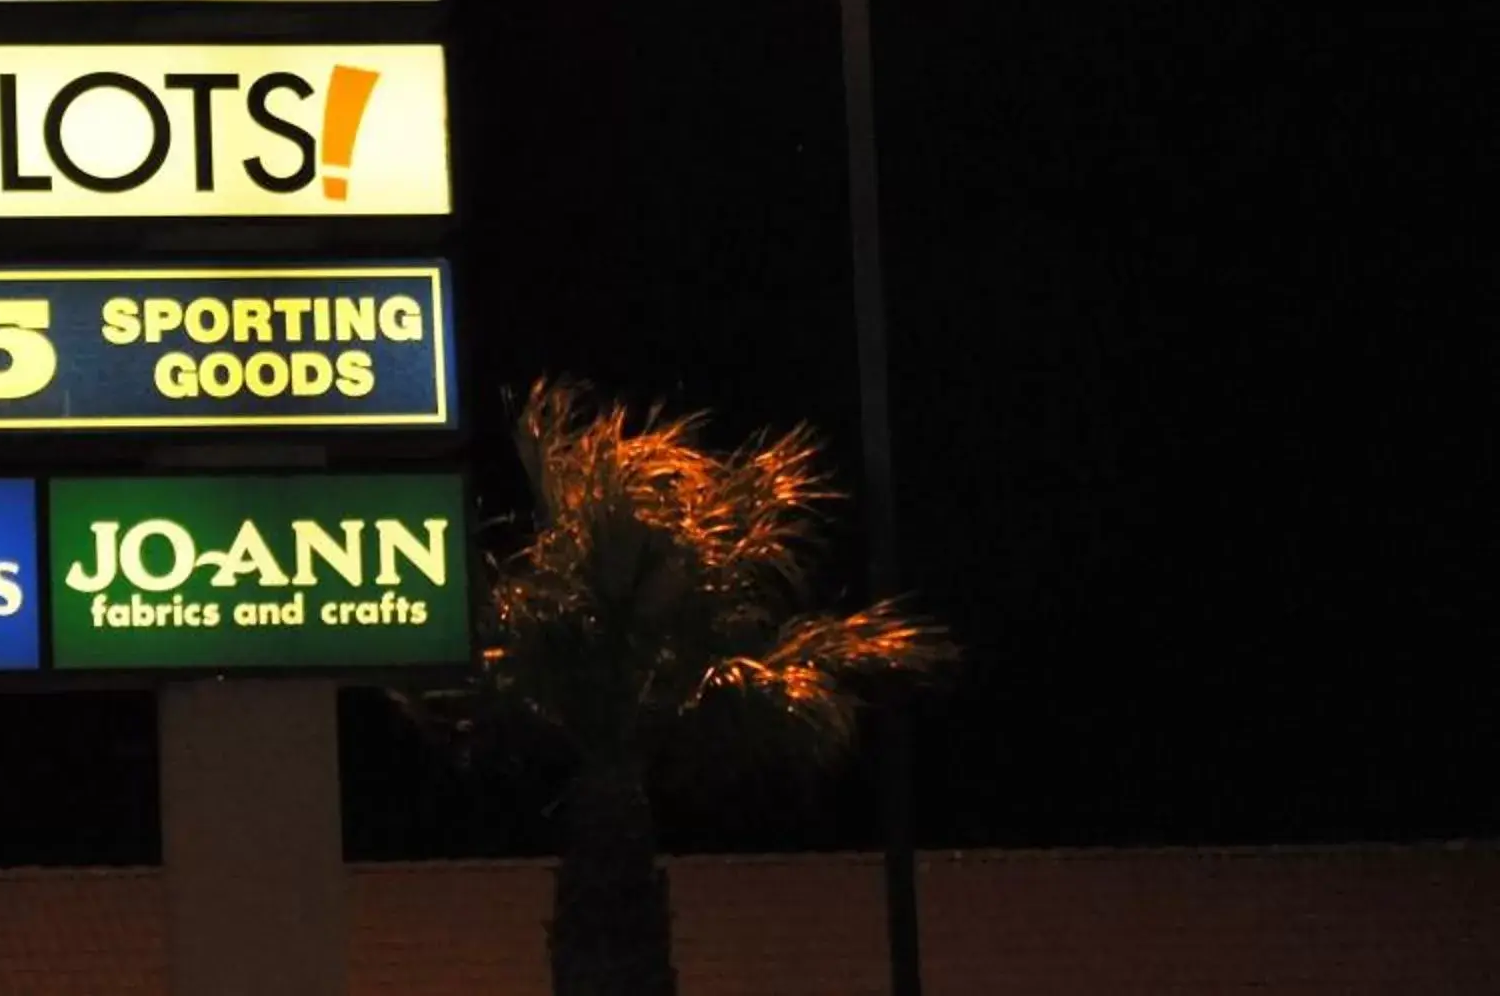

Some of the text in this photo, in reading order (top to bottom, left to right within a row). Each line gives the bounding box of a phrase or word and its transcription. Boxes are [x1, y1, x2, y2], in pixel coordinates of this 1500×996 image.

[101, 295, 423, 345] SPORTING
[154, 350, 375, 399] GOODS
[91, 591, 427, 627] fabrics and crafts
